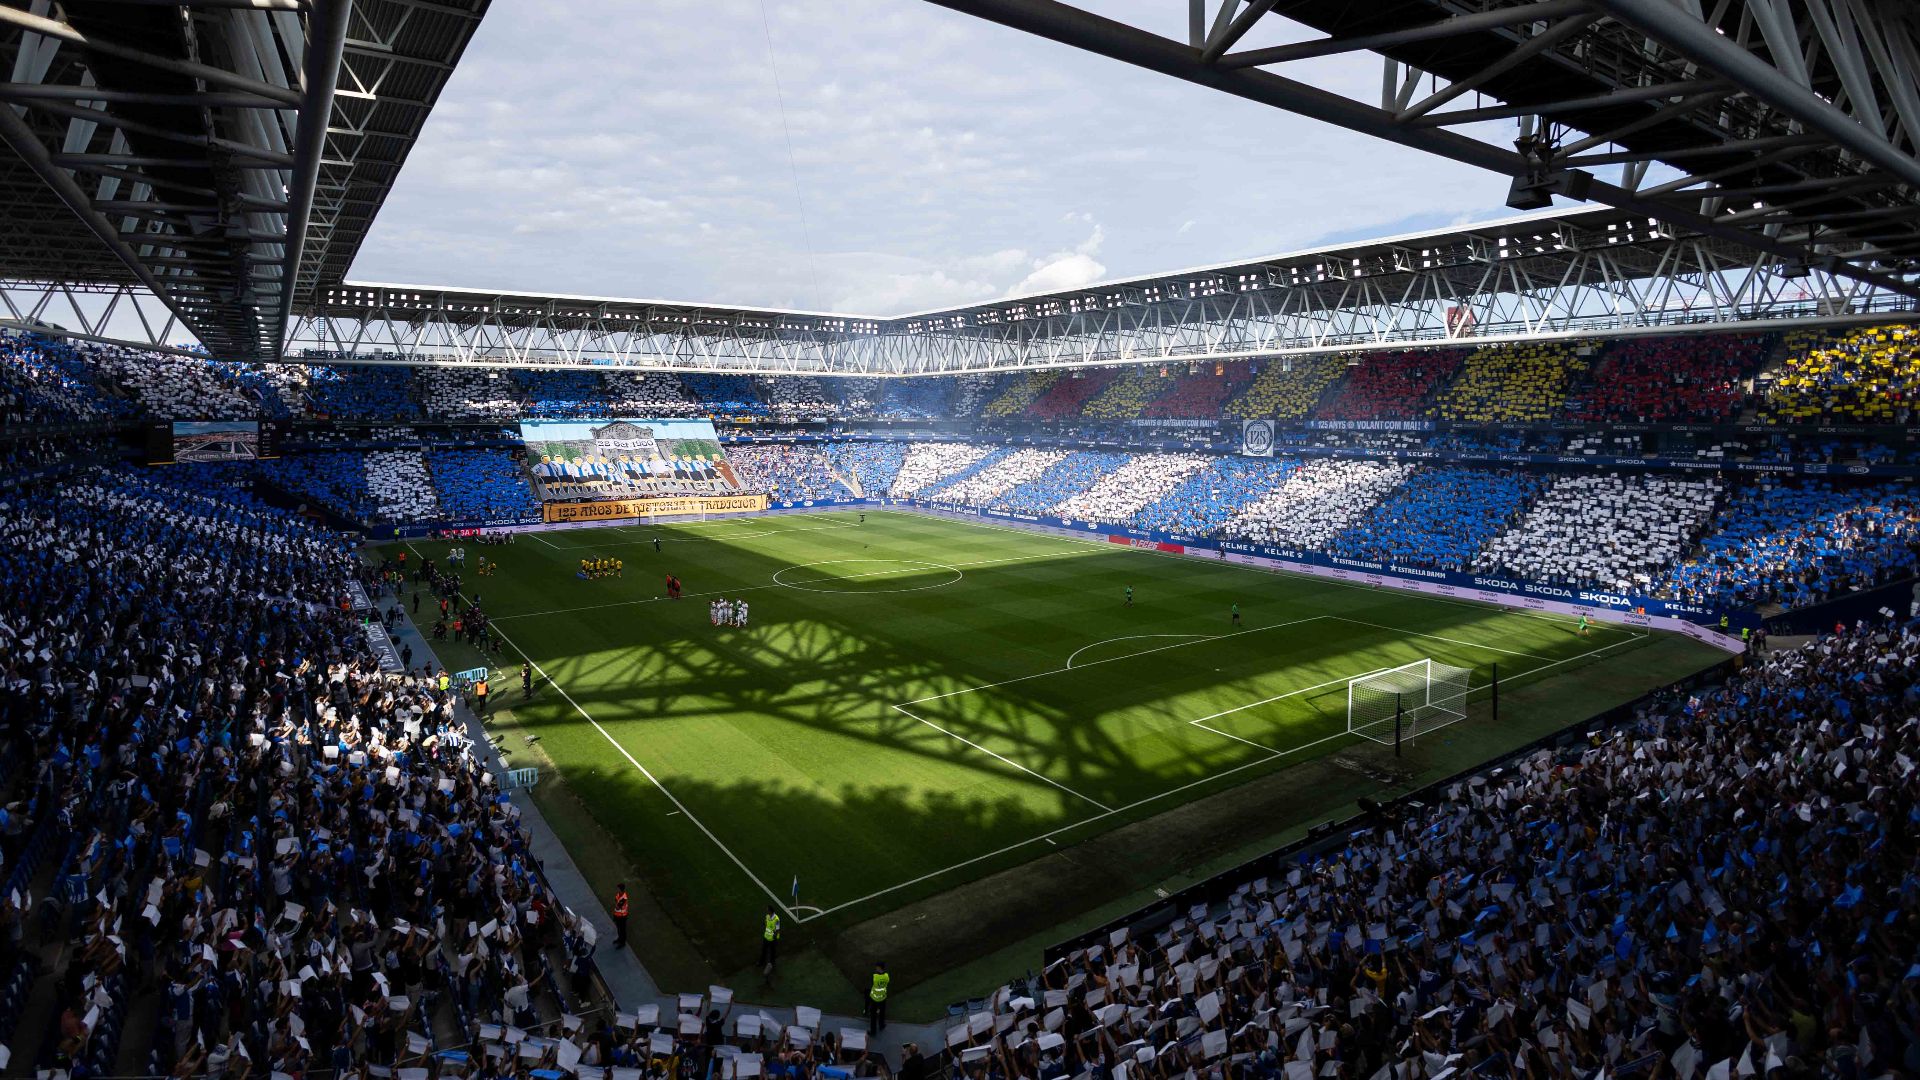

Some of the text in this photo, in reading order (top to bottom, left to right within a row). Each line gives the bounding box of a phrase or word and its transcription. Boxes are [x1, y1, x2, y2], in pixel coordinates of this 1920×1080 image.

[1318, 420, 1328, 429] 125
[1329, 420, 1346, 429] ANYS
[1356, 421, 1384, 430] VOLANT
[1384, 421, 1401, 430] COM
[558, 507, 577, 517] 125
[580, 504, 612, 517] AÑOS
[615, 504, 630, 514] DE
[485, 518, 516, 526] SKODA
[1220, 541, 1248, 551] KELME
[1264, 548, 1295, 558] KELME
[1339, 558, 1382, 570] ESTRELLA DAMM
[1398, 566, 1446, 579] ESTRELLA DAMM
[1475, 577, 1519, 590] SKODA
[1525, 584, 1572, 598] SKODA
[1580, 592, 1632, 606] SKODA
[1665, 602, 1703, 614] KELME
